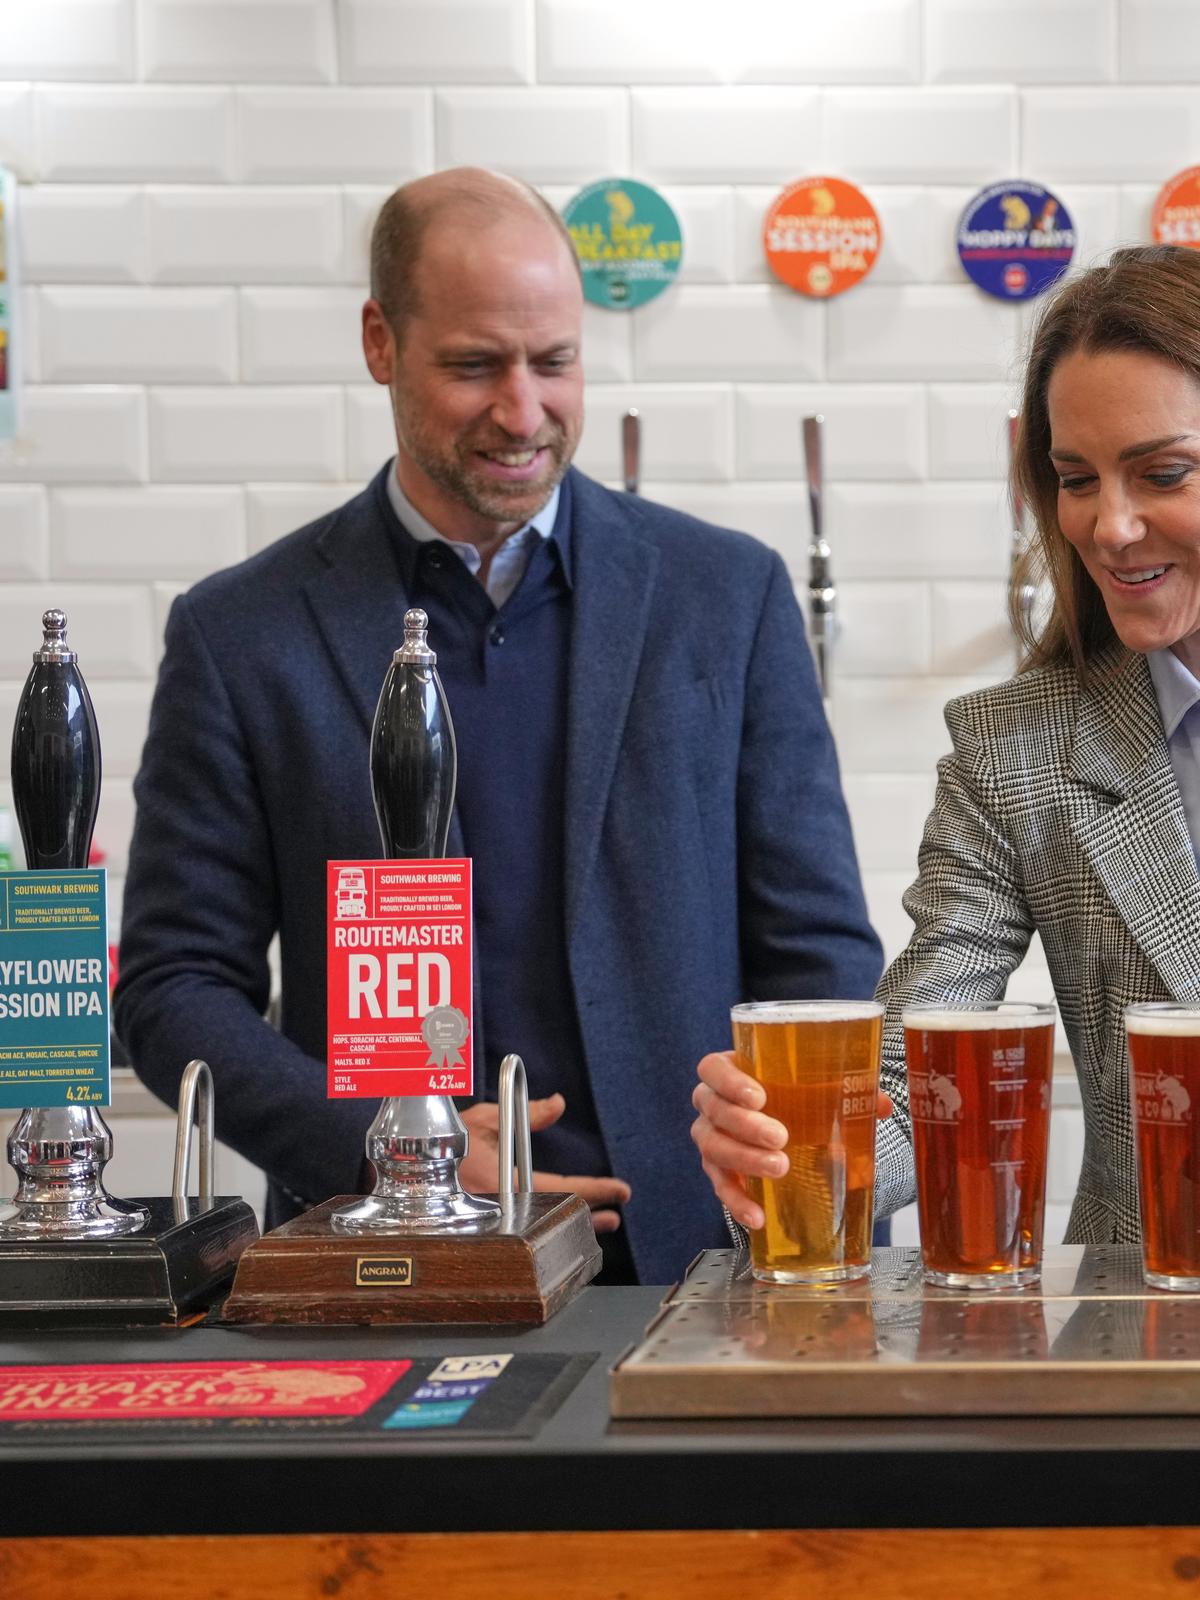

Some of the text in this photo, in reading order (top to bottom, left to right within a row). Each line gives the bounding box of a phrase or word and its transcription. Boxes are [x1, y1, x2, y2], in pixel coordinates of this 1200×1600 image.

[768, 229, 877, 253] SESSION
[961, 230, 1076, 248] HOPPY DAYS
[830, 251, 867, 271] IPA
[380, 874, 462, 884] SOUTHWARK BREWING
[14, 884, 99, 895] SOUTHWARK BREWING
[380, 904, 402, 912] PROUDLY
[403, 904, 425, 912] CRAFTED
[442, 903, 462, 911] LONDON
[335, 925, 463, 948] ROUTEMASTER
[0, 959, 103, 985] YFLOWER
[348, 952, 451, 1019] RED
[67, 991, 103, 1017] IPA
[350, 1036, 374, 1044] SORACHI
[350, 1044, 376, 1052] CASCADE
[334, 1076, 351, 1084] STYLE
[66, 1086, 91, 1101] 4.2%
[334, 1084, 346, 1092] RED
[361, 1267, 407, 1276] ANGRAM
[440, 1359, 501, 1373] LPA
[0, 1379, 216, 1397] HWARK
[414, 1385, 481, 1399] BEST
